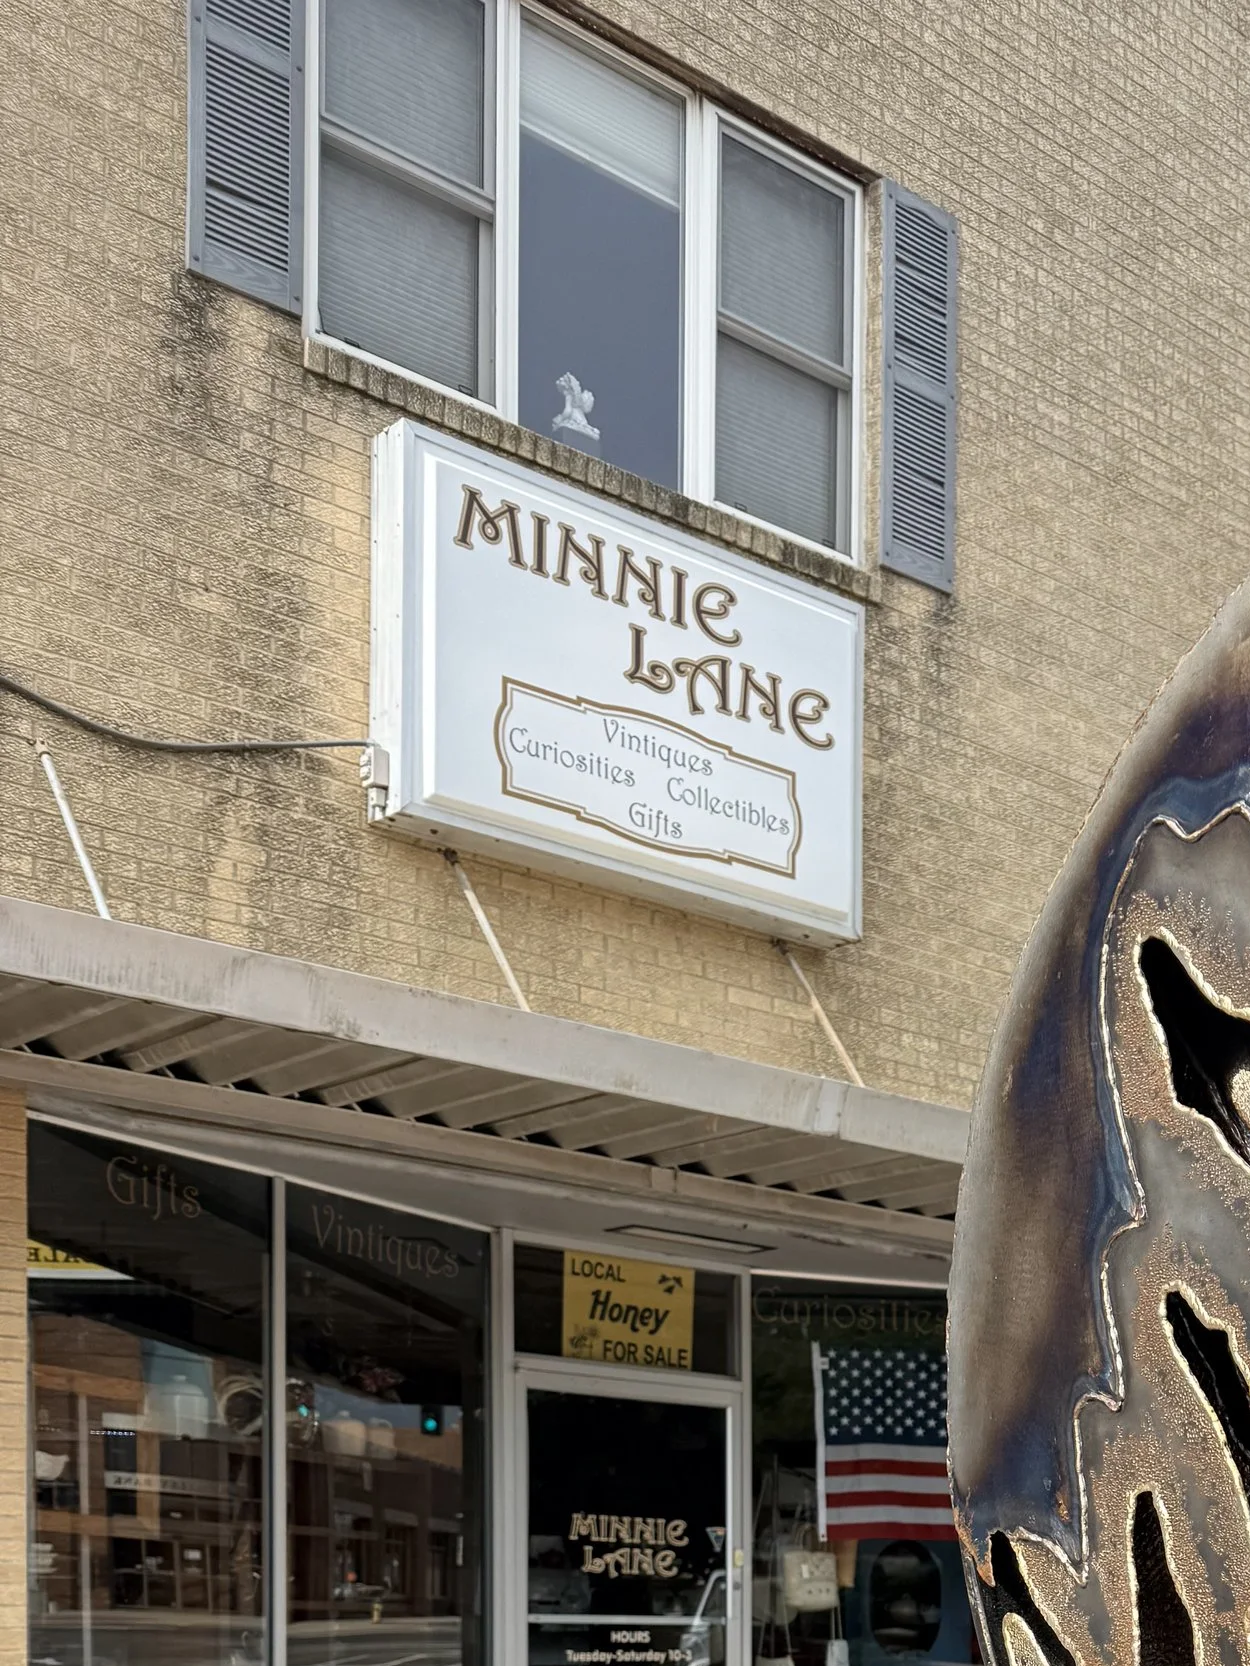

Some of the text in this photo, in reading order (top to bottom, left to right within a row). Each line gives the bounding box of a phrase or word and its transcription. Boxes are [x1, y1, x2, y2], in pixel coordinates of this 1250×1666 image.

[453, 483, 742, 647] MINNIE
[624, 622, 836, 751] LANE
[508, 725, 636, 788] Curiosities
[602, 718, 713, 777] Vintiques
[628, 803, 683, 840] Gifts
[667, 777, 791, 836] Collectibles
[107, 1156, 201, 1222] Gifts
[312, 1204, 460, 1278] Vintiques
[571, 1258, 626, 1283] LOCAL
[589, 1289, 670, 1335] Honey
[602, 1339, 689, 1369] FOR SALE
[568, 1512, 689, 1547] MINNIE
[581, 1545, 679, 1579] LANE
[610, 1630, 651, 1644] HOURS
